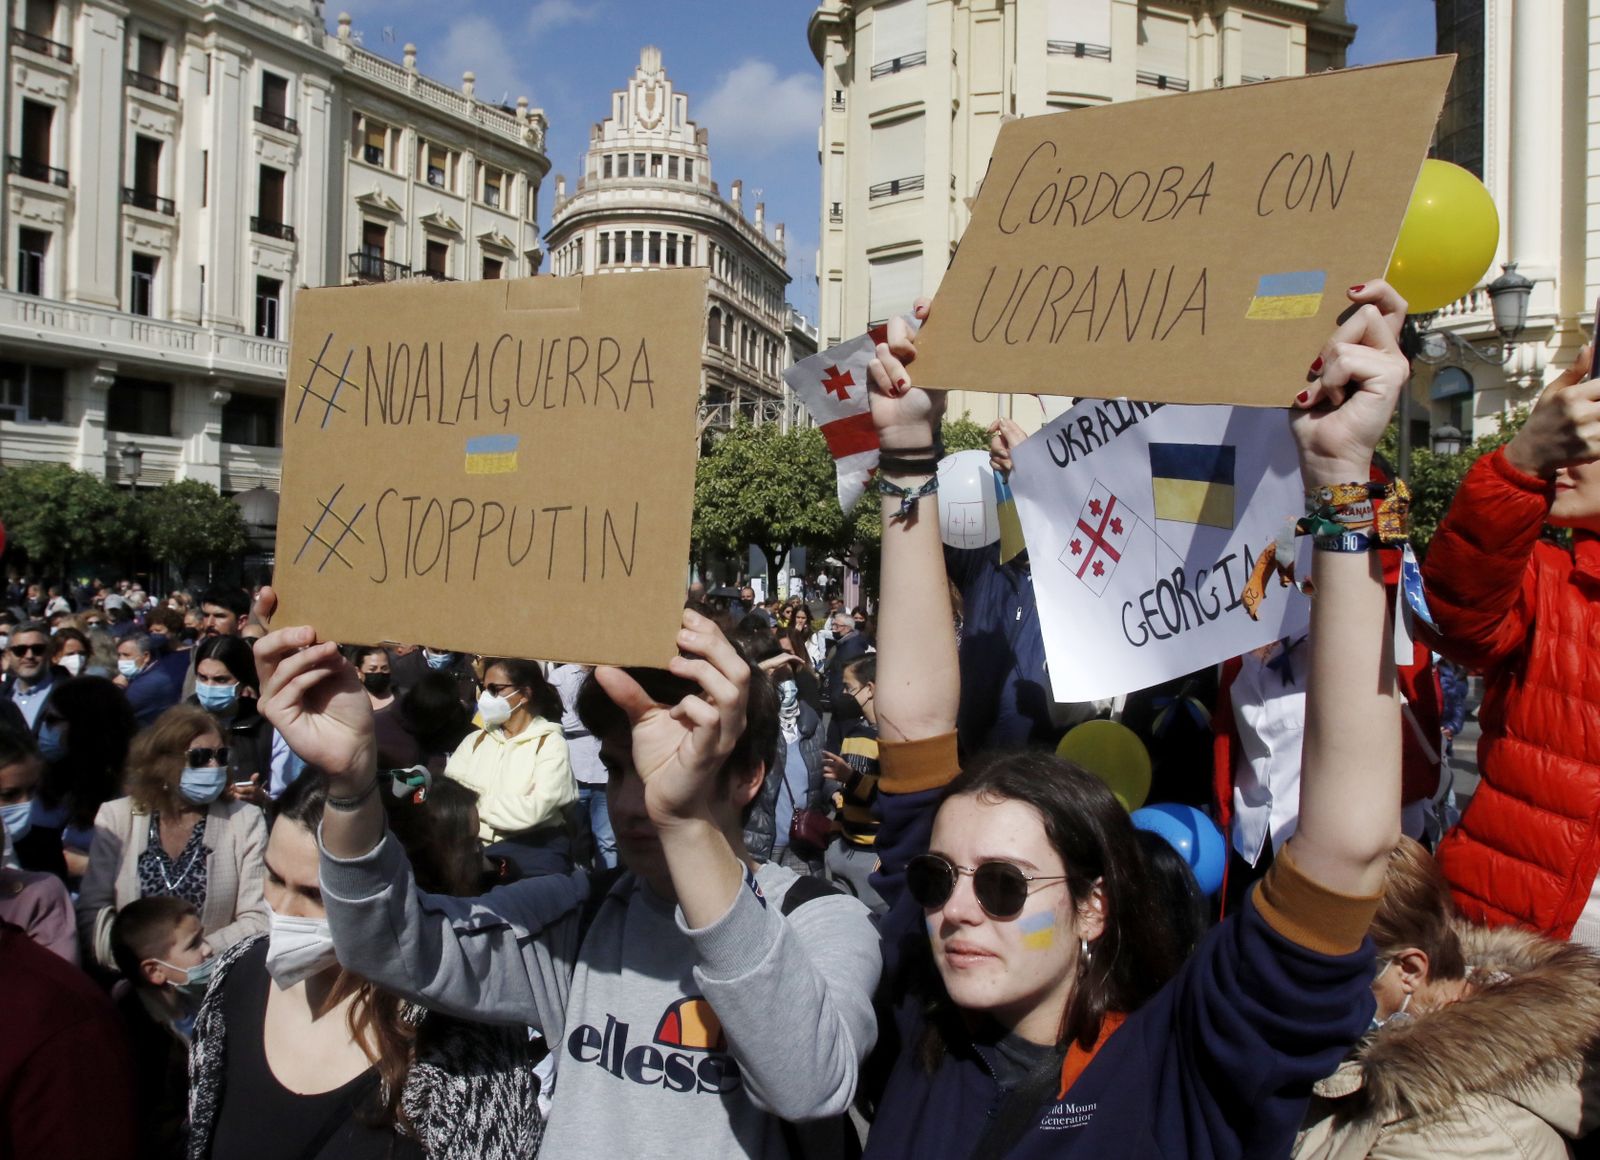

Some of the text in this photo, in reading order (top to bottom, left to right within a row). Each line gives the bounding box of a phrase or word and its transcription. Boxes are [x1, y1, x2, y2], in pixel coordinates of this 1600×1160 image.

[1257, 150, 1355, 217] CON
[972, 264, 1207, 345] UCRANIA
[294, 332, 655, 430] #NOALAGUERRA
[1046, 400, 1166, 468] UKRAIN
[293, 483, 638, 583] #STOPPUTIN
[567, 1013, 741, 1094] ellesse
